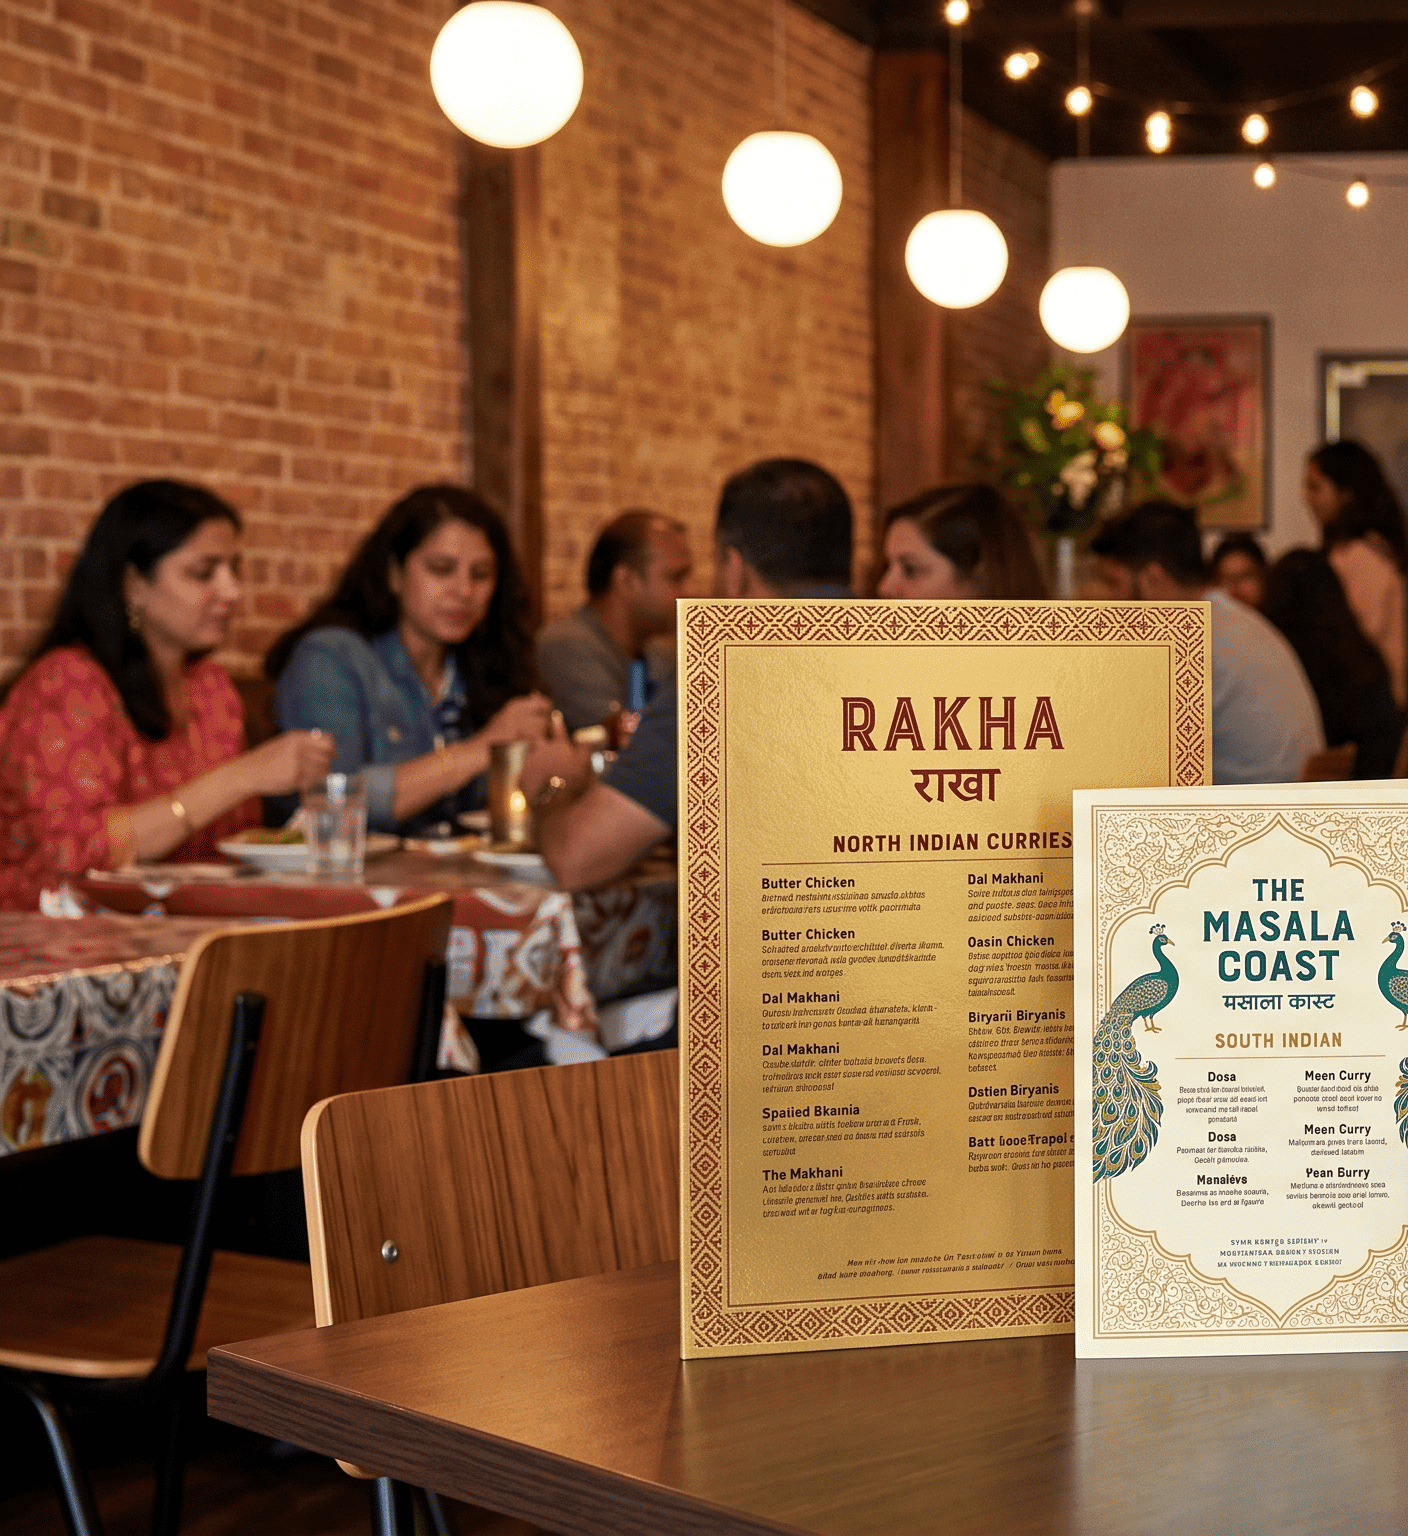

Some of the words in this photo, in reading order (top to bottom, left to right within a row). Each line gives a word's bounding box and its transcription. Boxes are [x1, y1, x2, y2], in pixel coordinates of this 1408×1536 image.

[840, 696, 1064, 752] RAKHA
[910, 768, 1001, 803] राखा
[833, 834, 901, 854] NORTH
[910, 833, 979, 852] INDIAN
[987, 832, 1073, 851] CURRIES
[762, 878, 801, 889] Butter
[805, 877, 855, 888] Chicken
[968, 874, 987, 885] Dal
[992, 872, 1044, 884] Makhani
[1252, 878, 1305, 902] THE
[1203, 910, 1355, 942] MASALA
[762, 930, 801, 941] Butter
[806, 928, 855, 940] Chicken
[1007, 935, 1055, 946] Chicken
[1218, 949, 1340, 982] COAST
[762, 993, 783, 1004] Dal
[787, 991, 840, 1003] Makhani
[1289, 994, 1336, 1011] कास्ट
[1017, 1009, 1066, 1023] Biryanis
[1215, 1033, 1274, 1049] SOUTH
[1282, 1032, 1342, 1048] INDIAN
[762, 1044, 783, 1056] Dal
[787, 1042, 840, 1054] Makhani
[1208, 1071, 1236, 1082] Dosa
[1305, 1070, 1335, 1081] Meen
[1339, 1070, 1371, 1083] Curry
[1010, 1083, 1059, 1098] Biryanis
[1208, 1132, 1236, 1142] Dosa
[1304, 1124, 1335, 1135] Meen
[1339, 1123, 1371, 1137] Curry
[762, 1169, 786, 1181] The
[790, 1166, 843, 1179] Makhani
